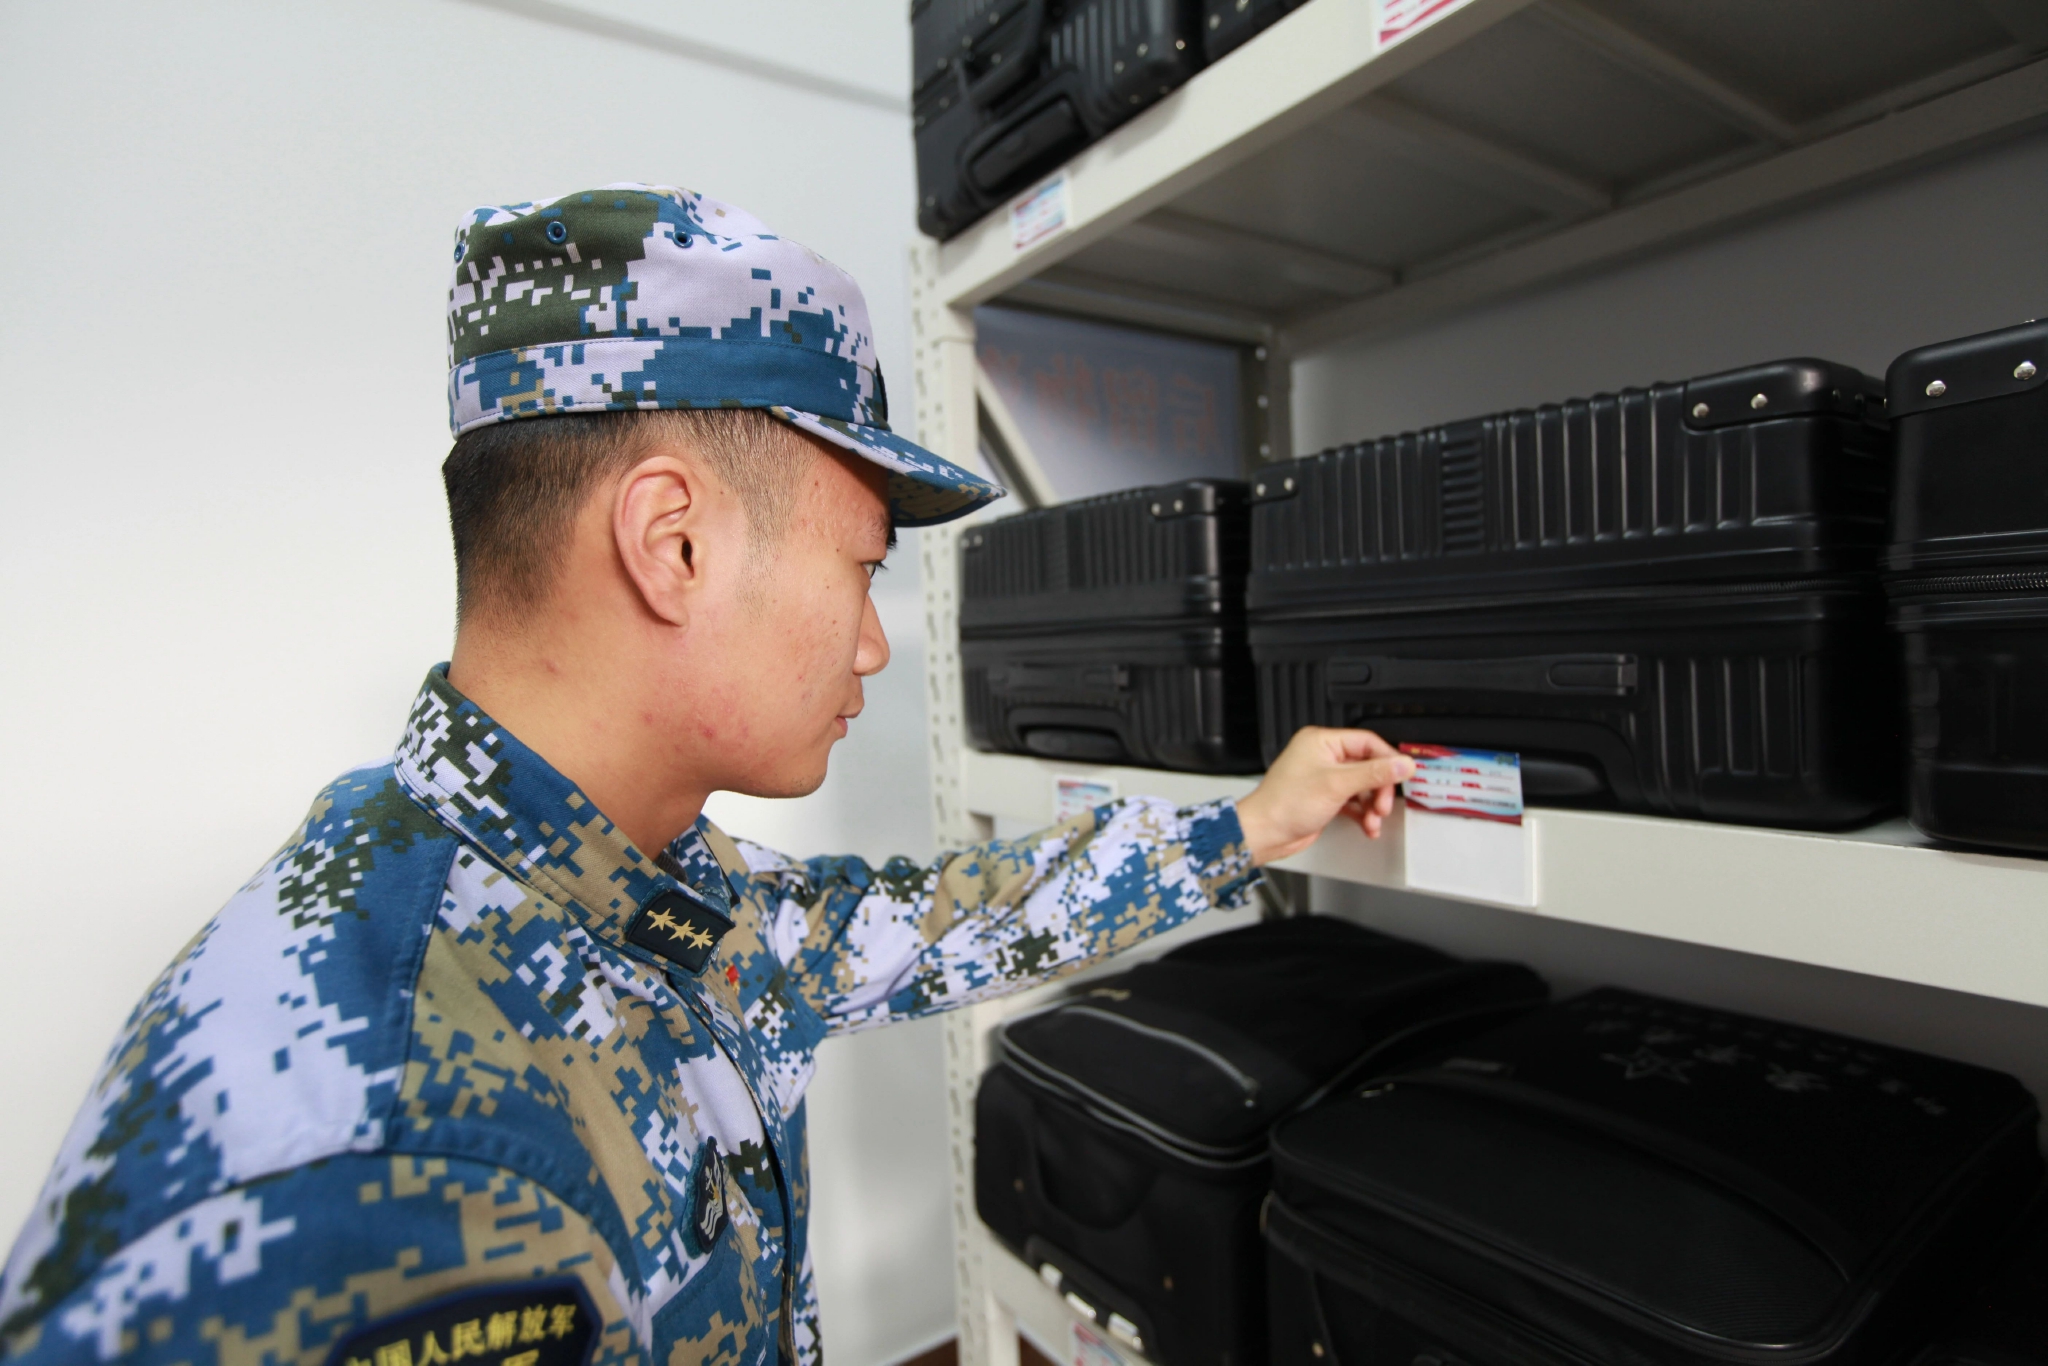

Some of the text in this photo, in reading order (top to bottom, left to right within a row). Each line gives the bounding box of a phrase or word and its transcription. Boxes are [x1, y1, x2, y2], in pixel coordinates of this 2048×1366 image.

[345, 1304, 577, 1366] 国人民解放军
